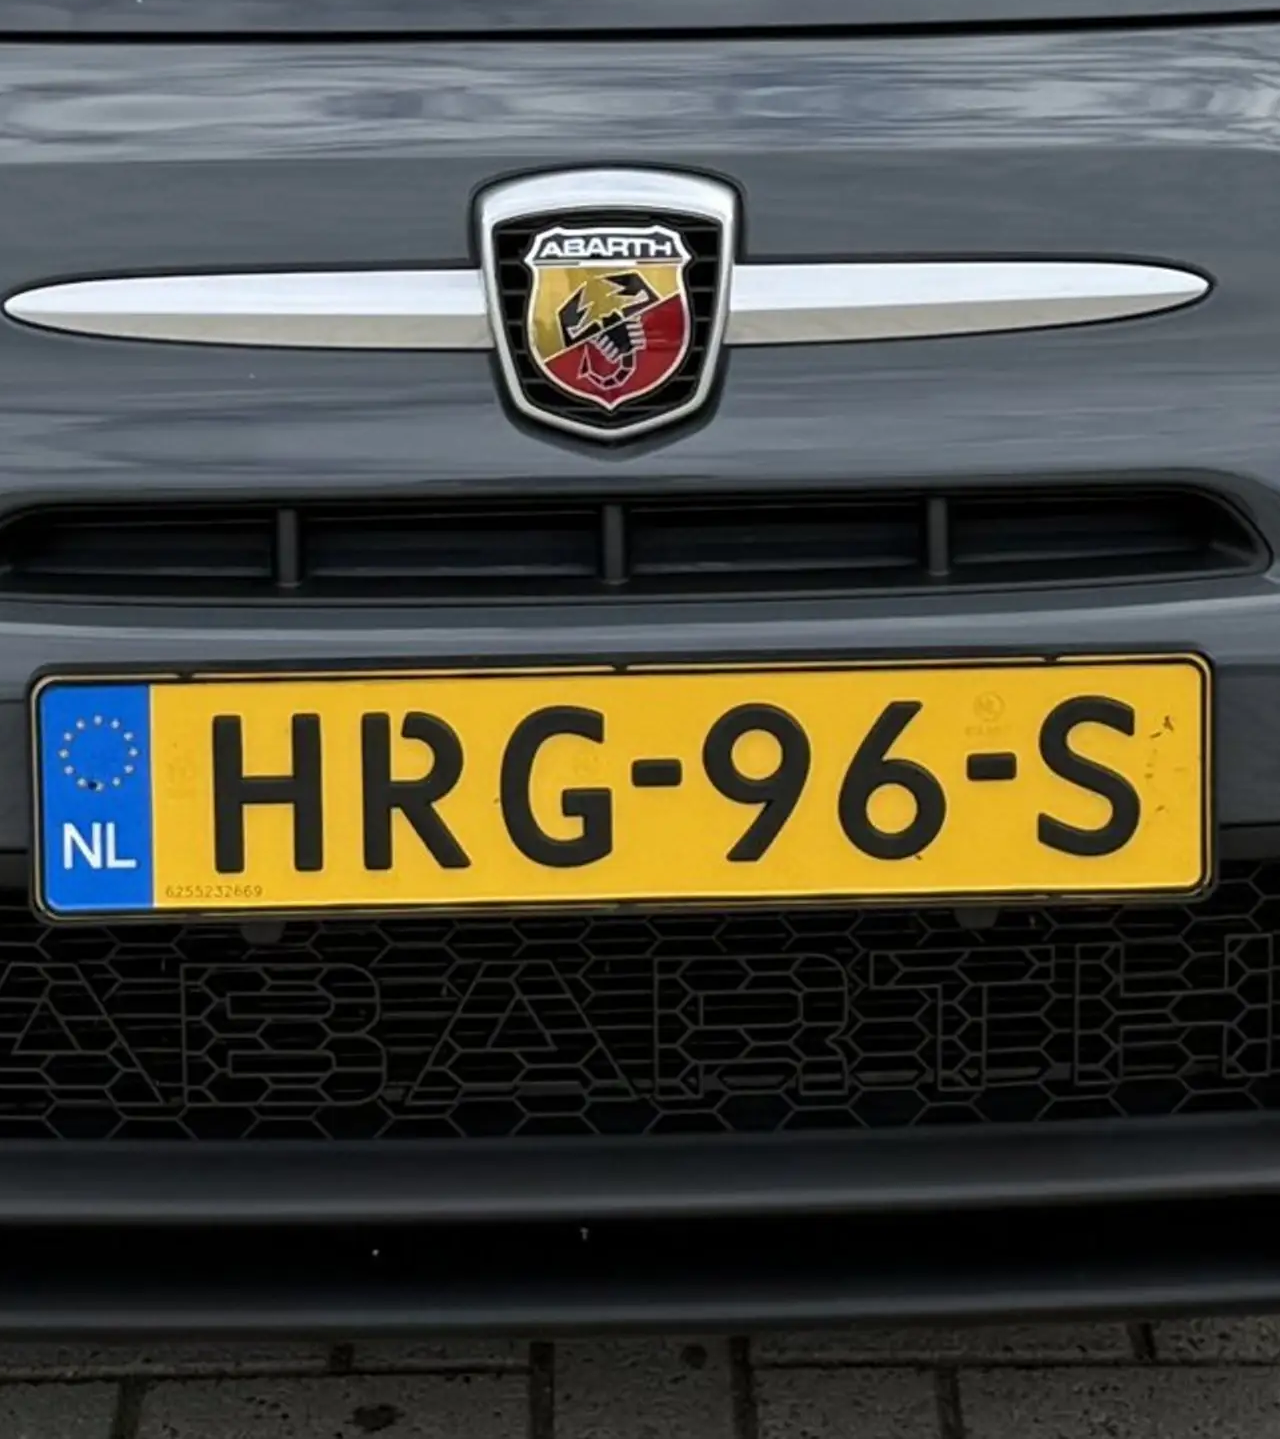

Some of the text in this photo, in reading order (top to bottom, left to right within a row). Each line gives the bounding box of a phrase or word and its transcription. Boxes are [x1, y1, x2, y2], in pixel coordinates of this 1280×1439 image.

[541, 237, 671, 257] ABARTH
[213, 696, 1140, 873] HRG-96-S
[63, 822, 137, 870] NL
